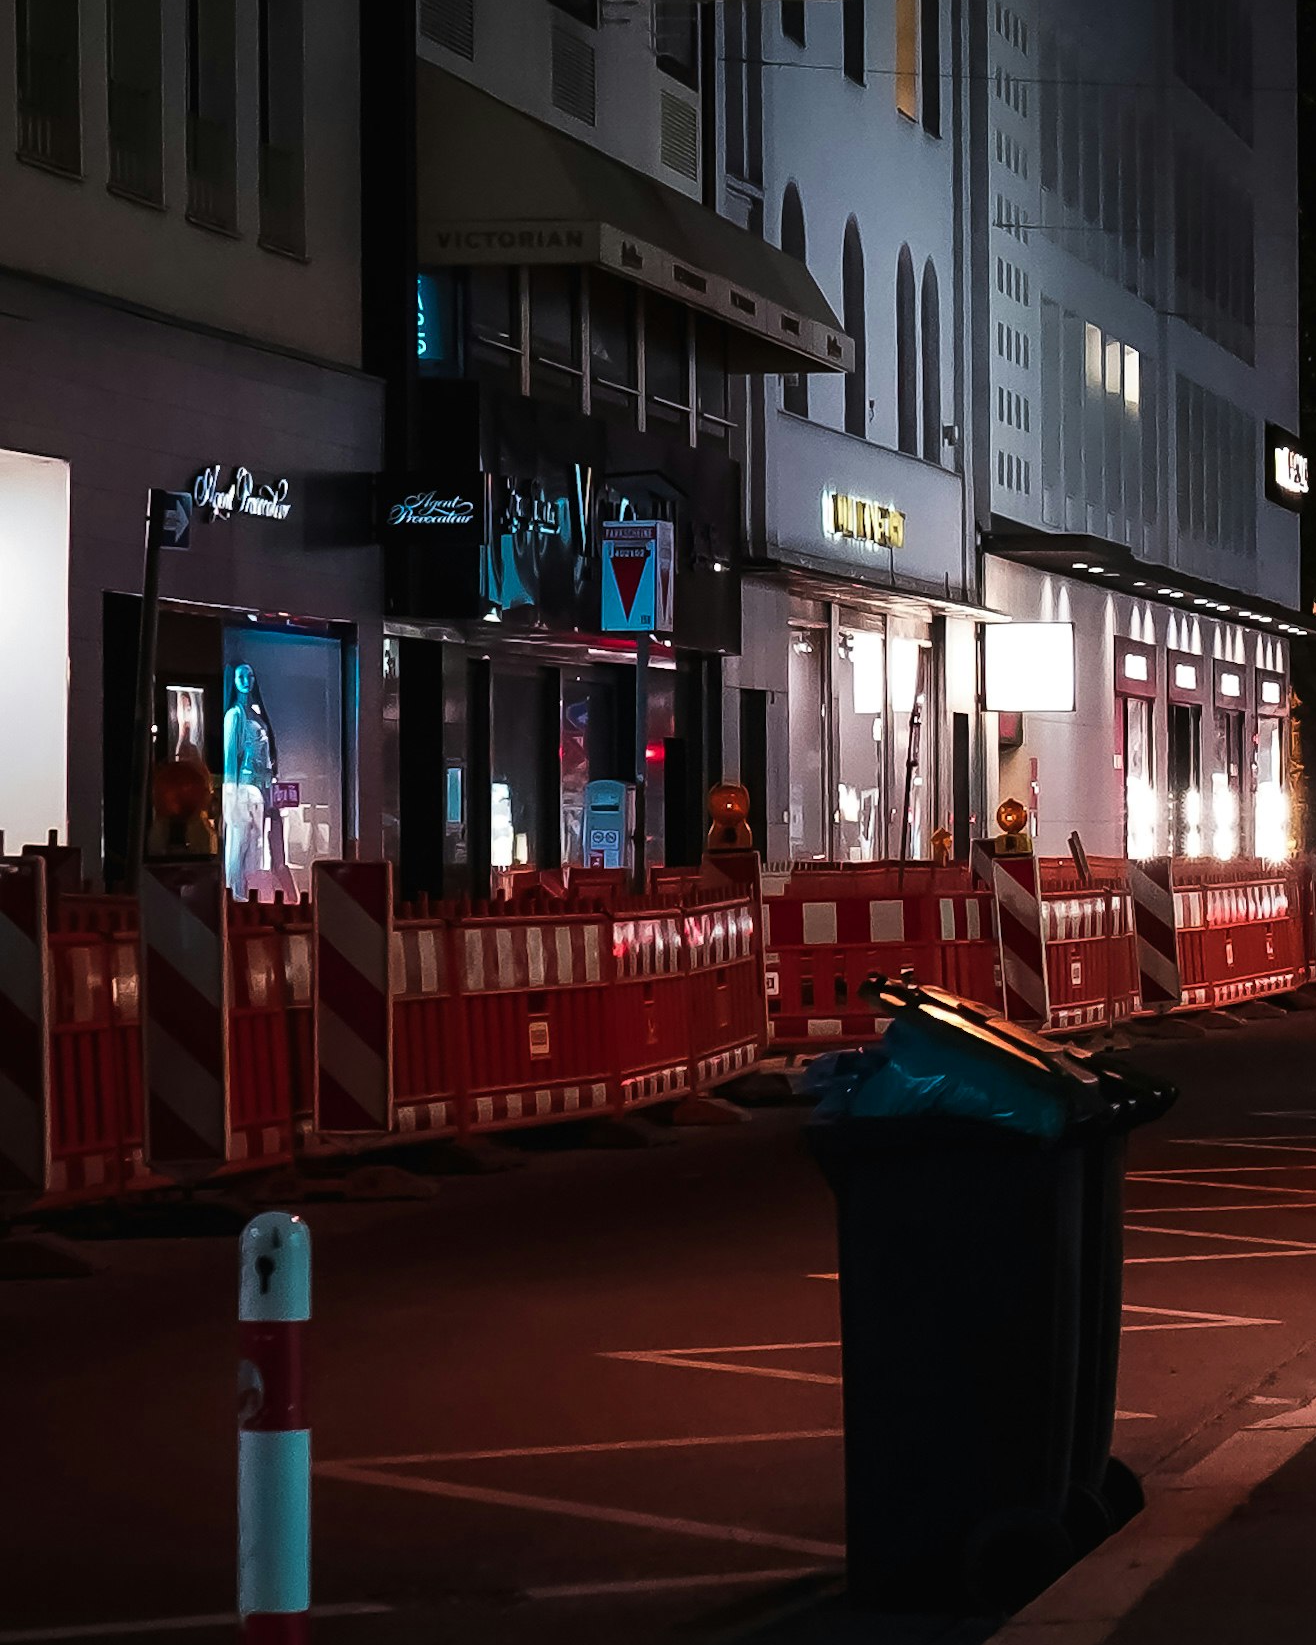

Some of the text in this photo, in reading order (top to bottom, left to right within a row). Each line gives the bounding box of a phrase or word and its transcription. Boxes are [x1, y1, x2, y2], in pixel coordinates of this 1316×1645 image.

[437, 230, 583, 249] VICTORIAN
[403, 489, 474, 516] Agent
[386, 504, 474, 525] Provocateur
